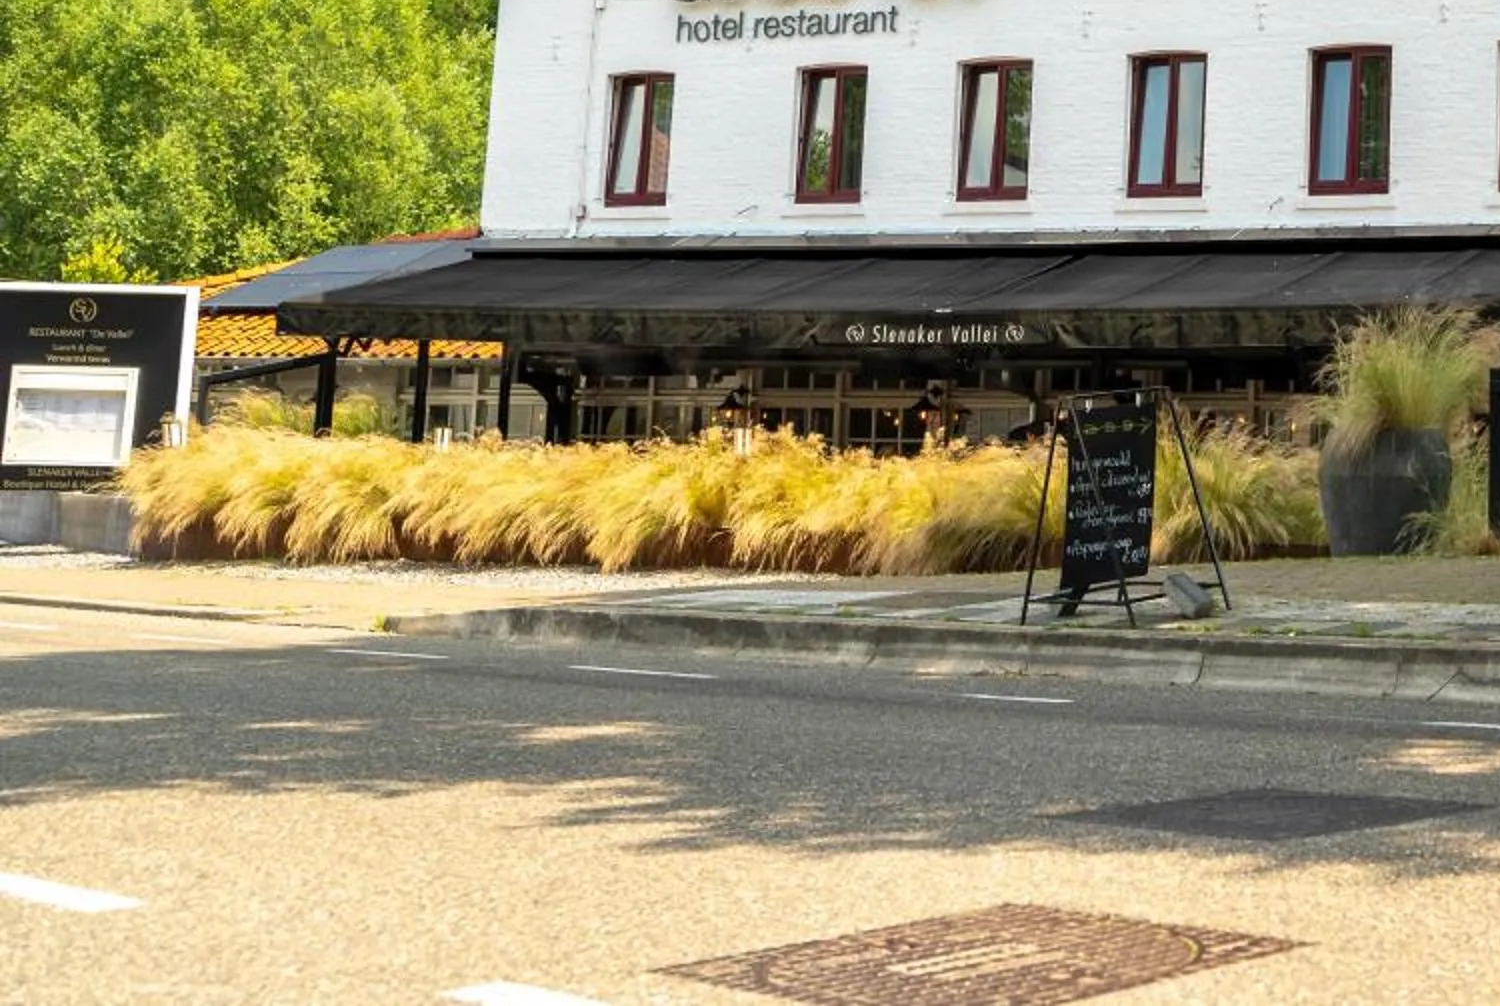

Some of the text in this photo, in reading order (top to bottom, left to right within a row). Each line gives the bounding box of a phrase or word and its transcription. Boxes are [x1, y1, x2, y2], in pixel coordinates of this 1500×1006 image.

[675, 6, 899, 43] hotel restaurant
[29, 327, 85, 338] RESTAURANT
[872, 324, 998, 343] Slenaker Vallei
